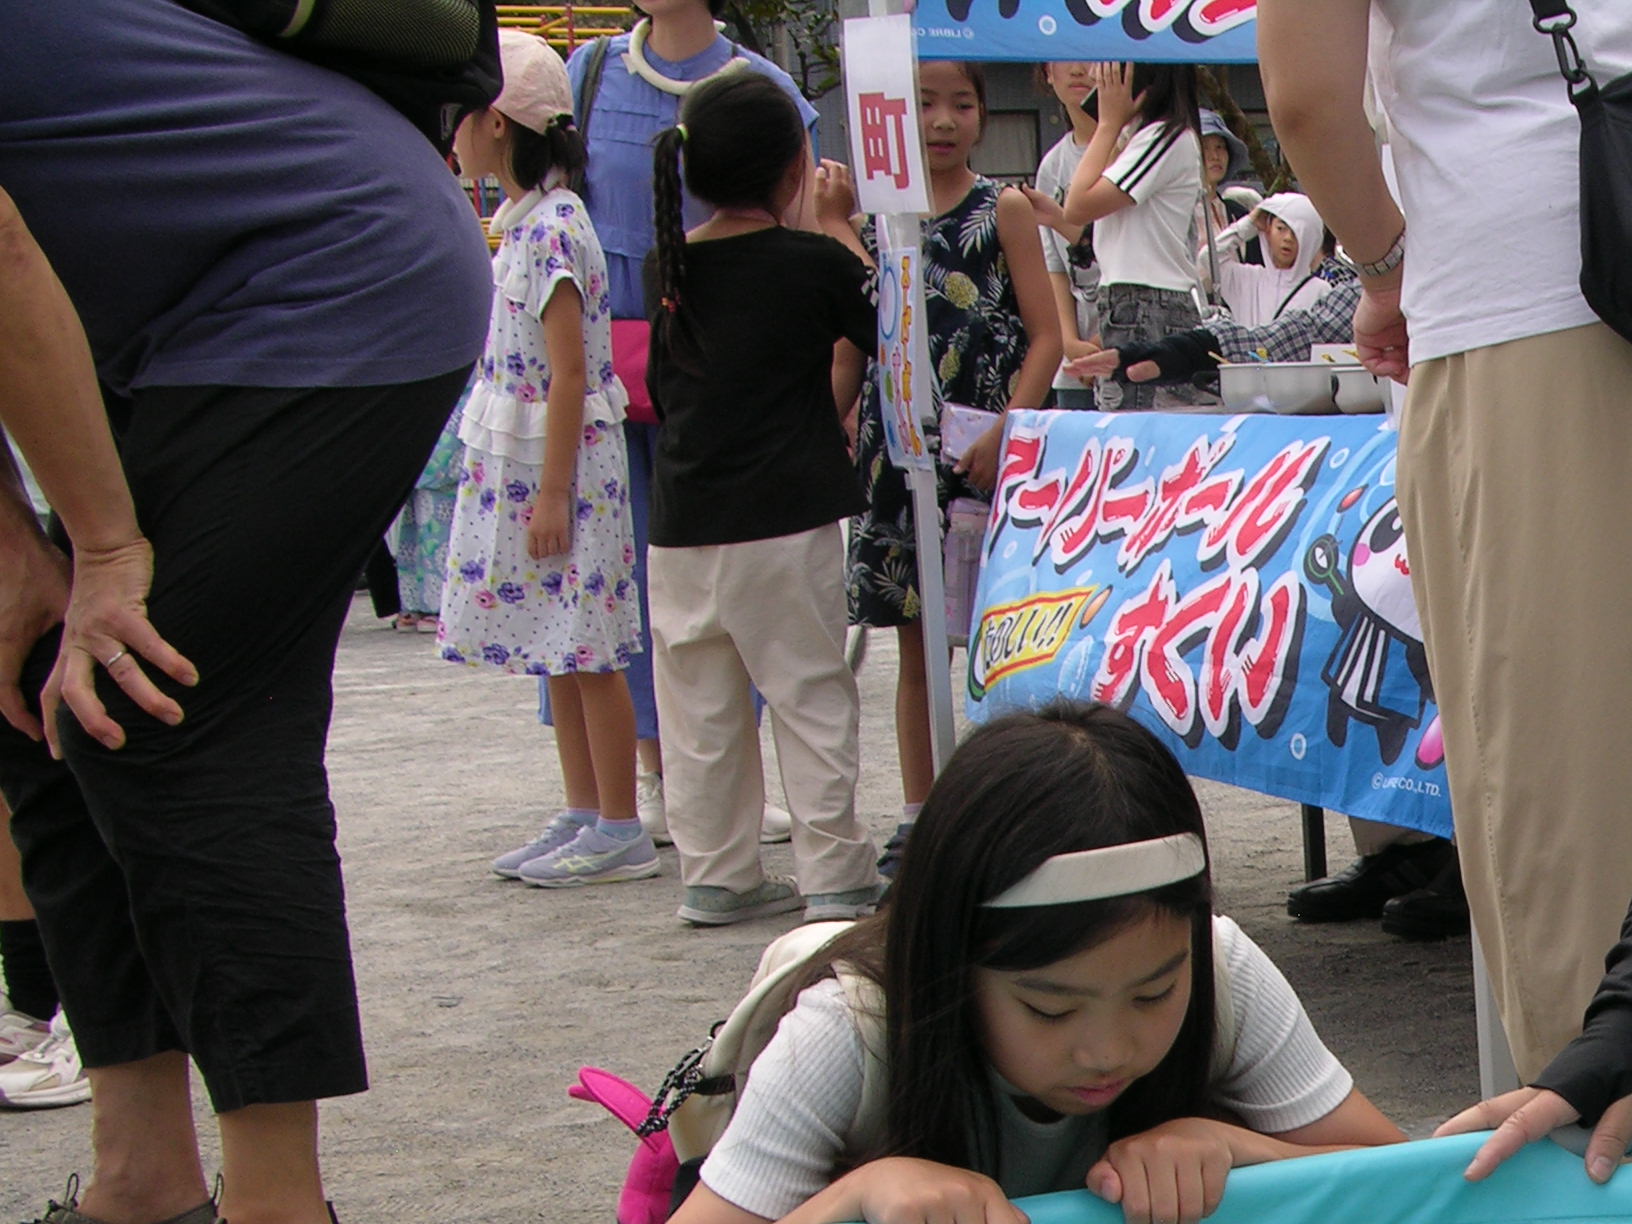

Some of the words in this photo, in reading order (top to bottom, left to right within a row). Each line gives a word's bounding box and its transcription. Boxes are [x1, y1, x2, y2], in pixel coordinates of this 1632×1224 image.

[859, 92, 908, 190] 町
[1091, 562, 1297, 735] すくい
